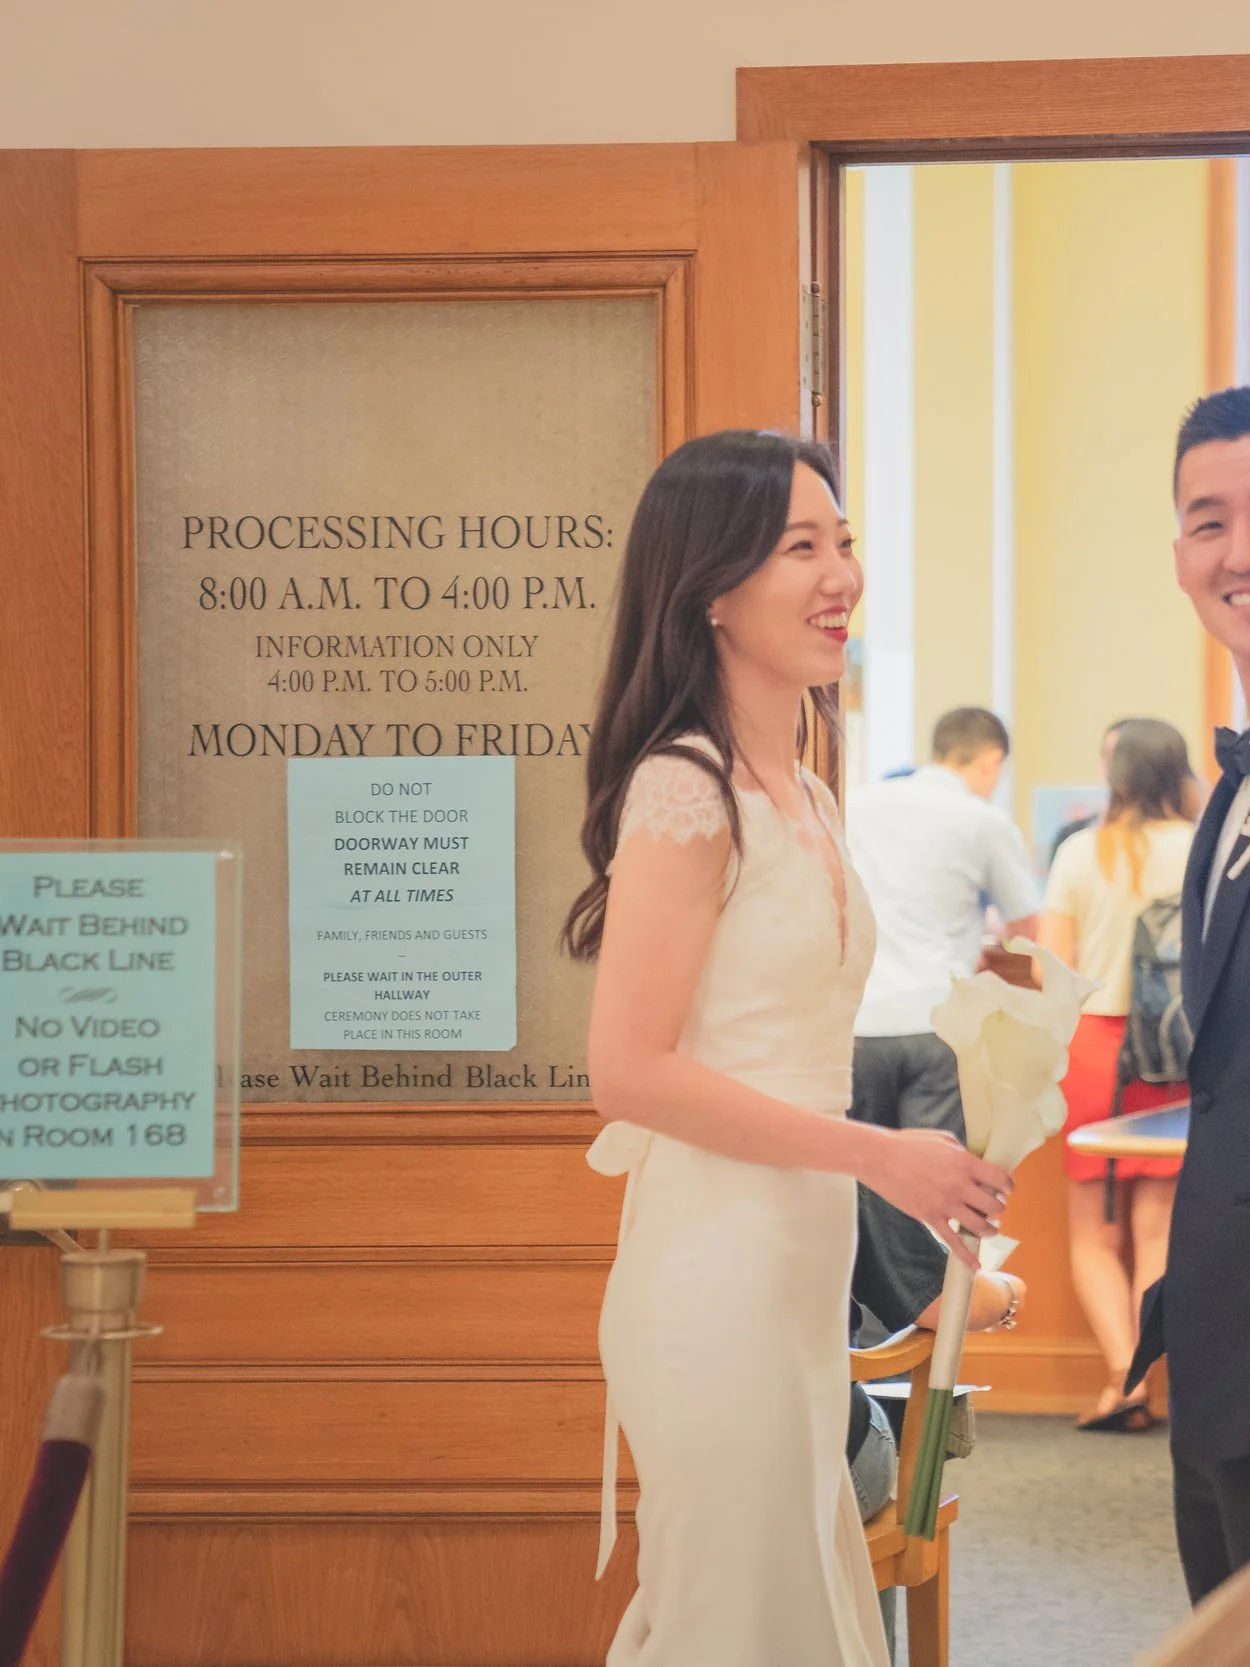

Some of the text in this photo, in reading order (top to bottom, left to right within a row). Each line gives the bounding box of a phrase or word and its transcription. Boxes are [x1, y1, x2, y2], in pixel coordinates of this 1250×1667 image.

[182, 514, 614, 550] PROCESSING HOURS:
[199, 574, 596, 611] 8:00 A.M. TO 4:00 P.M.
[254, 633, 539, 659] INFORMATION ONLY
[267, 668, 528, 693] 4:00 P.M. TO 5:00 P.M.
[187, 722, 375, 757] MONDAY
[385, 723, 442, 757] TO
[370, 782, 432, 796] DO NOT
[335, 809, 469, 824] BLOCK THE DOOR
[334, 836, 469, 851] DOORWAY MUST
[344, 861, 460, 876] REMAIN CLEAR
[350, 888, 454, 903] AT ALL TIMES
[317, 928, 488, 943] FAMILY, FRIENDS AND GUESTS
[323, 971, 482, 982] PLEASE WAIT IN THE OUTER
[374, 989, 431, 1001] HALLWAY
[324, 1010, 482, 1022] CEREMONY DOES NOT TAKE
[343, 1028, 462, 1040] PLACE IN THIS ROOM
[289, 1064, 351, 1089] Wait
[360, 1064, 453, 1089] Behind
[465, 1064, 539, 1088] Black
[548, 1064, 591, 1088] Lin
[0, 1091, 196, 1113] HOTOGRAPHY
[0, 1128, 14, 1148] N
[127, 1123, 188, 1147] 168
